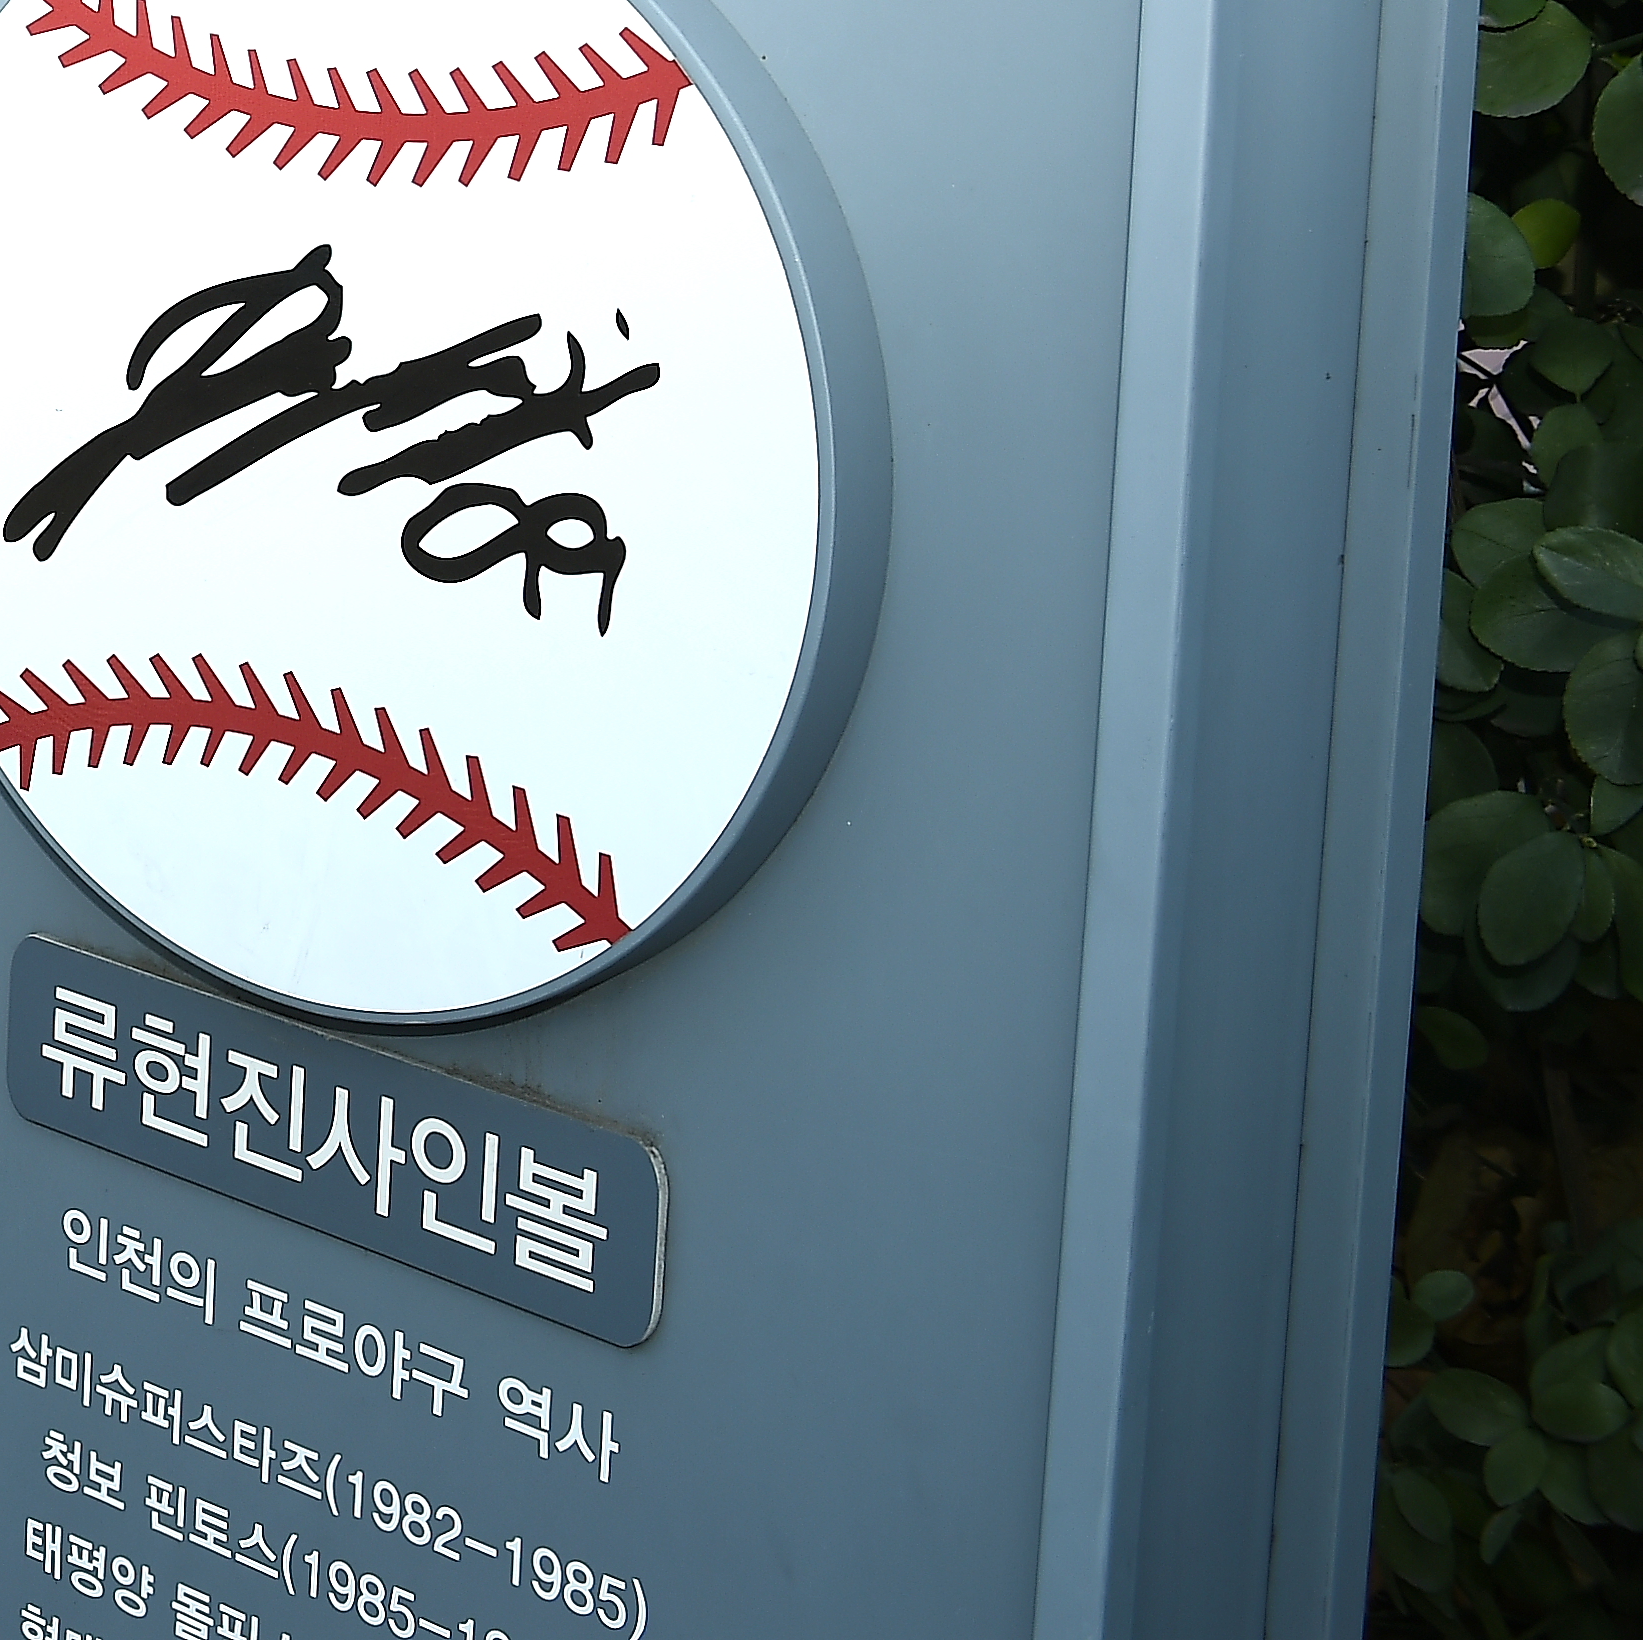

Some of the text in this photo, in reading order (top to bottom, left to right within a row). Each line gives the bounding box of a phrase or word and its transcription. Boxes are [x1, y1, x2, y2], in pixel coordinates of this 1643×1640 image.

[40, 985, 609, 1294] 류현진사인볼
[9, 1326, 648, 1640] 삼미슈퍼스타즈(1982-1985)
[40, 1429, 127, 1511] 청보
[61, 1208, 621, 1483] 인천의 프로야구 역사
[24, 1517, 156, 1618] 태평양
